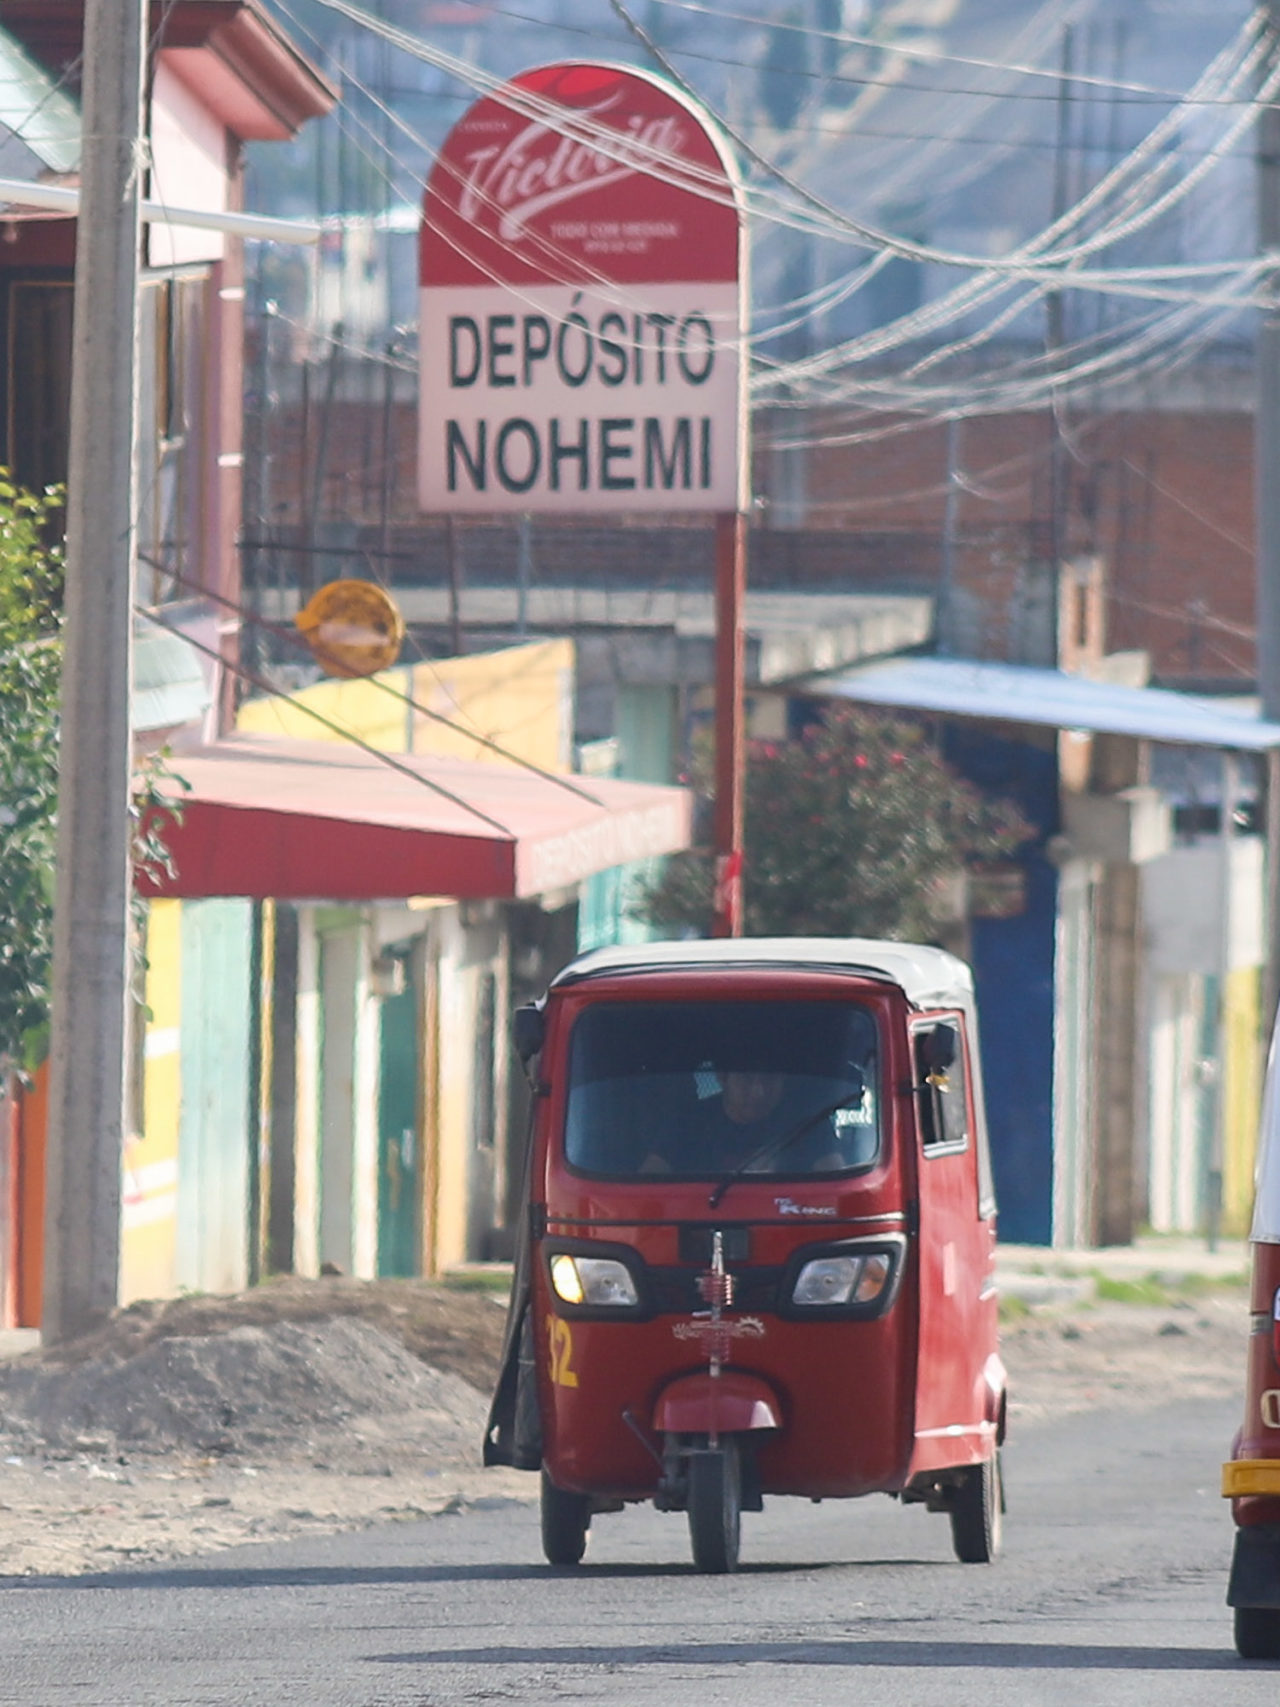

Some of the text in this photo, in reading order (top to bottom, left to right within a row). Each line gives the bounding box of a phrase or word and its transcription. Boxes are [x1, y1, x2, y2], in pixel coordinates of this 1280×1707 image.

[459, 92, 685, 242] Victoria
[450, 291, 715, 388] DEPÓSITO
[447, 418, 711, 493] NOHEMI
